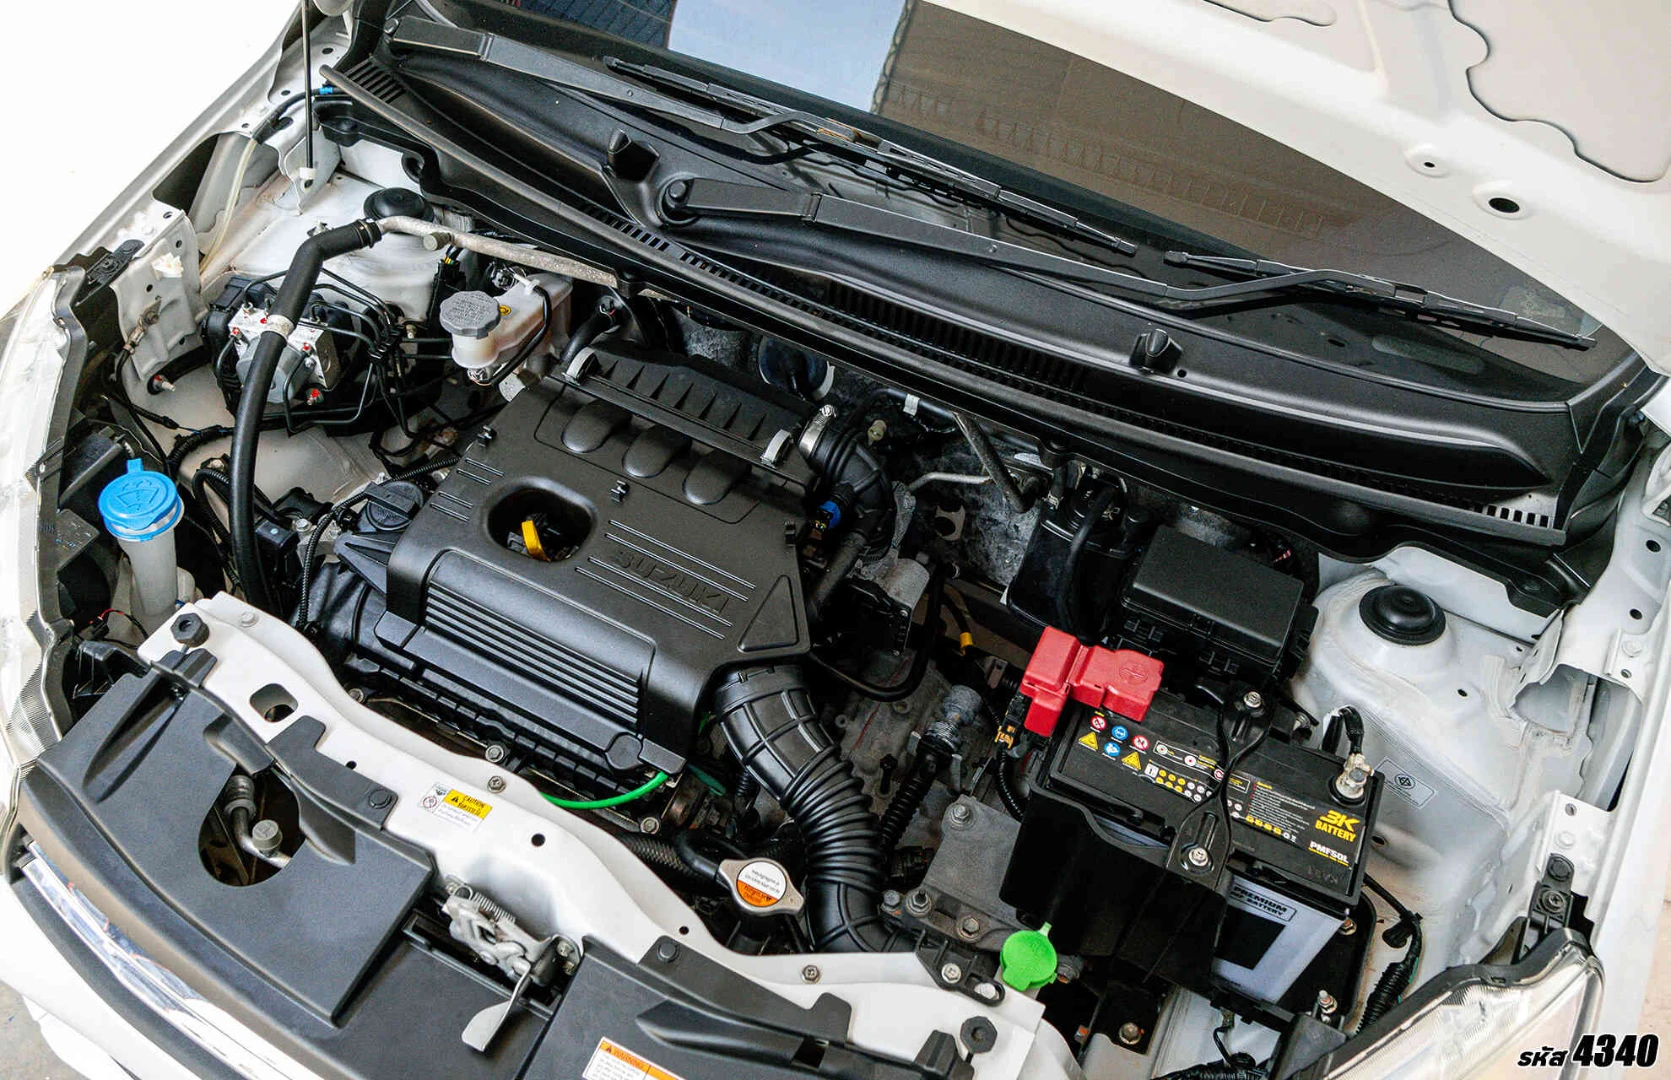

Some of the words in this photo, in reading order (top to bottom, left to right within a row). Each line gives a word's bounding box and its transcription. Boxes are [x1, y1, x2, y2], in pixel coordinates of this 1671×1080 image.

[613, 550, 730, 614] SUZUKI
[1315, 819, 1356, 842] BATTERY
[1320, 810, 1360, 832] 3K
[1233, 886, 1287, 912] PREMIUM
[1247, 898, 1284, 916] BATTERY
